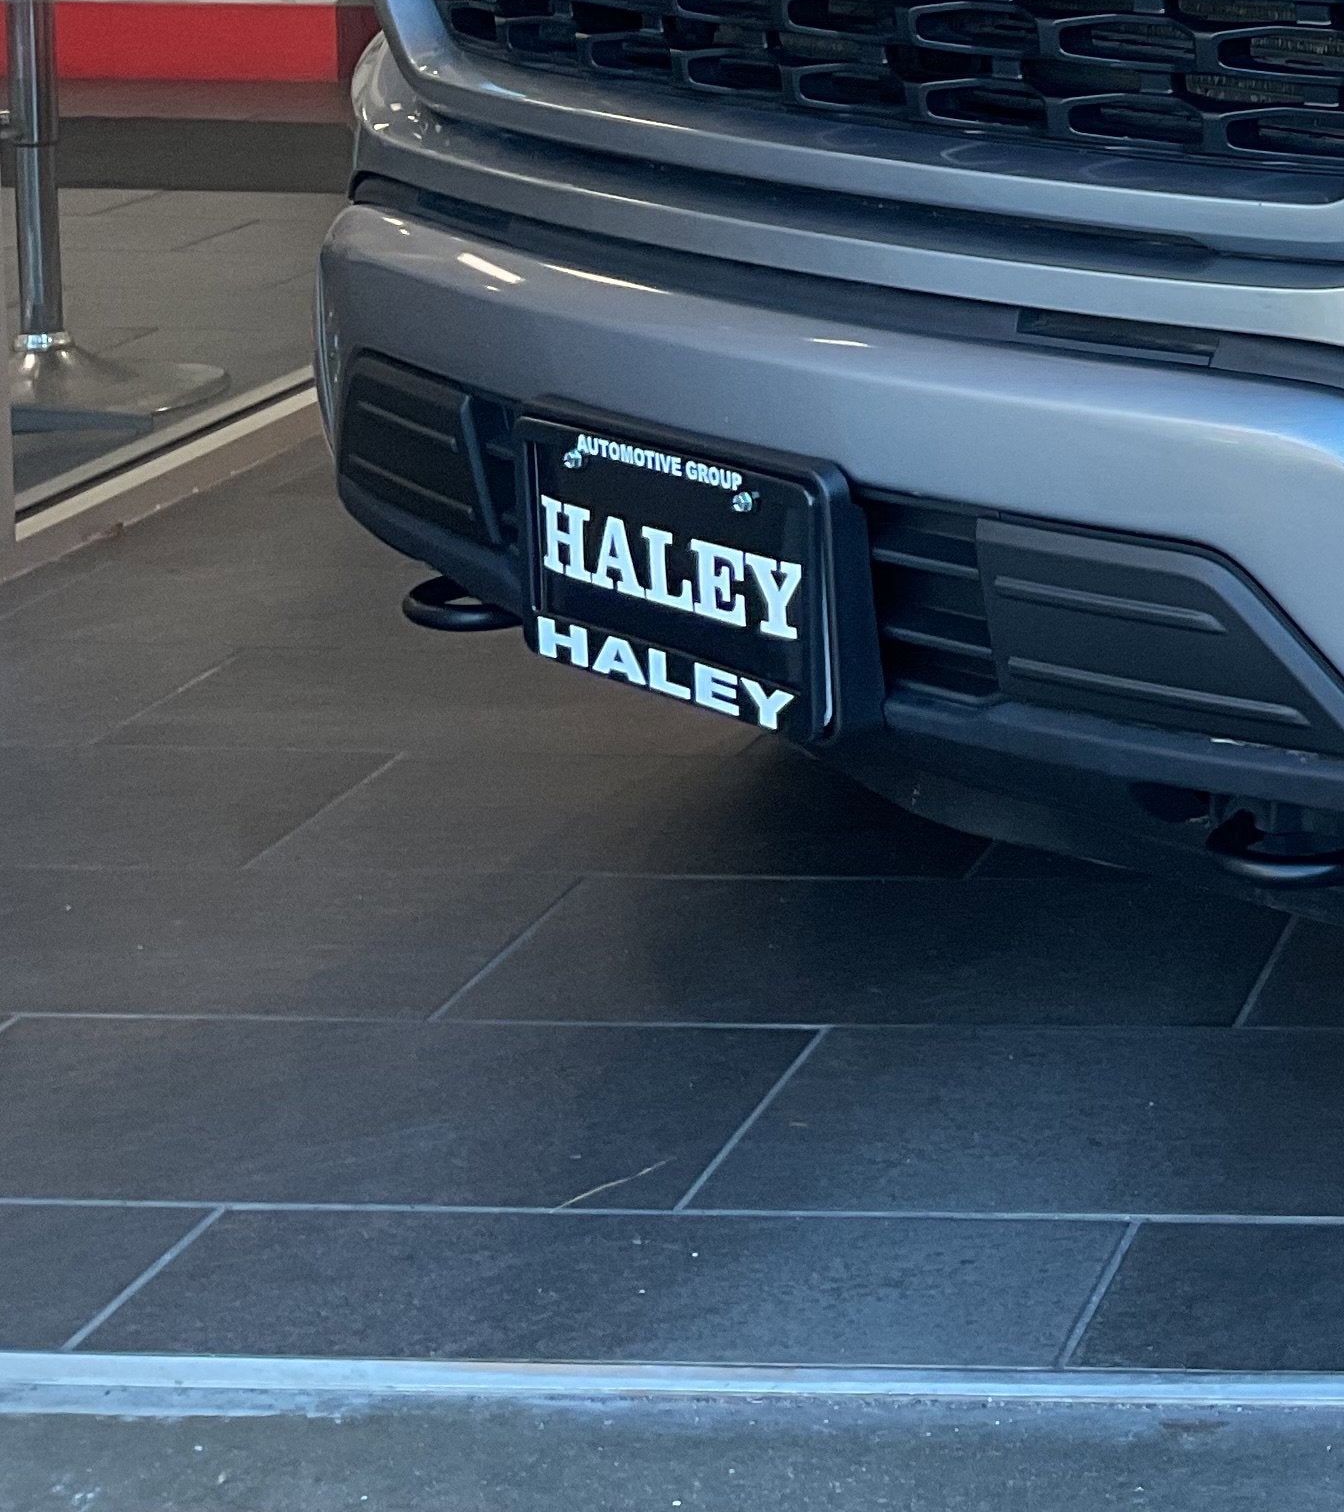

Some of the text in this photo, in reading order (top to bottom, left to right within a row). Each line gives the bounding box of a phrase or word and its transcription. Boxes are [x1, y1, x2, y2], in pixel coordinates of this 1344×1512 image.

[576, 433, 743, 491] AUTOMOTIVE GROUP
[540, 494, 802, 640] HALEY
[537, 615, 795, 730] HALEY
